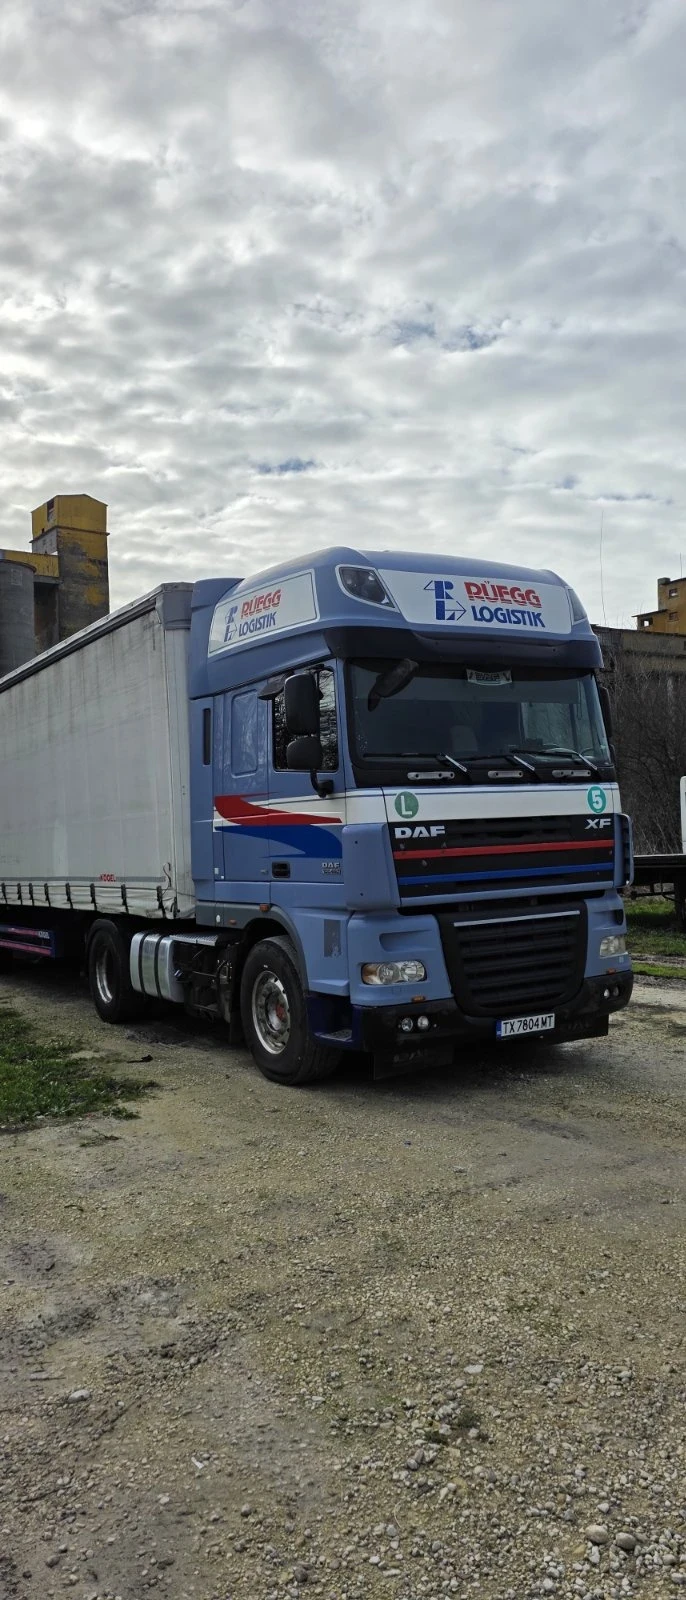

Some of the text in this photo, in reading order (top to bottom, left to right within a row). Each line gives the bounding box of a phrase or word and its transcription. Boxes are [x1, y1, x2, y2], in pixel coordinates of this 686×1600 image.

[240, 589, 282, 619] RÜEGG
[464, 580, 542, 608] RÜEGG
[238, 611, 277, 637] LOGISTIK
[471, 605, 546, 628] LOGISTIK
[395, 826, 446, 838] DAF
[584, 818, 611, 829] XF
[503, 1021, 514, 1034] TX
[518, 1018, 539, 1031] 7804
[541, 1015, 553, 1027] MT
